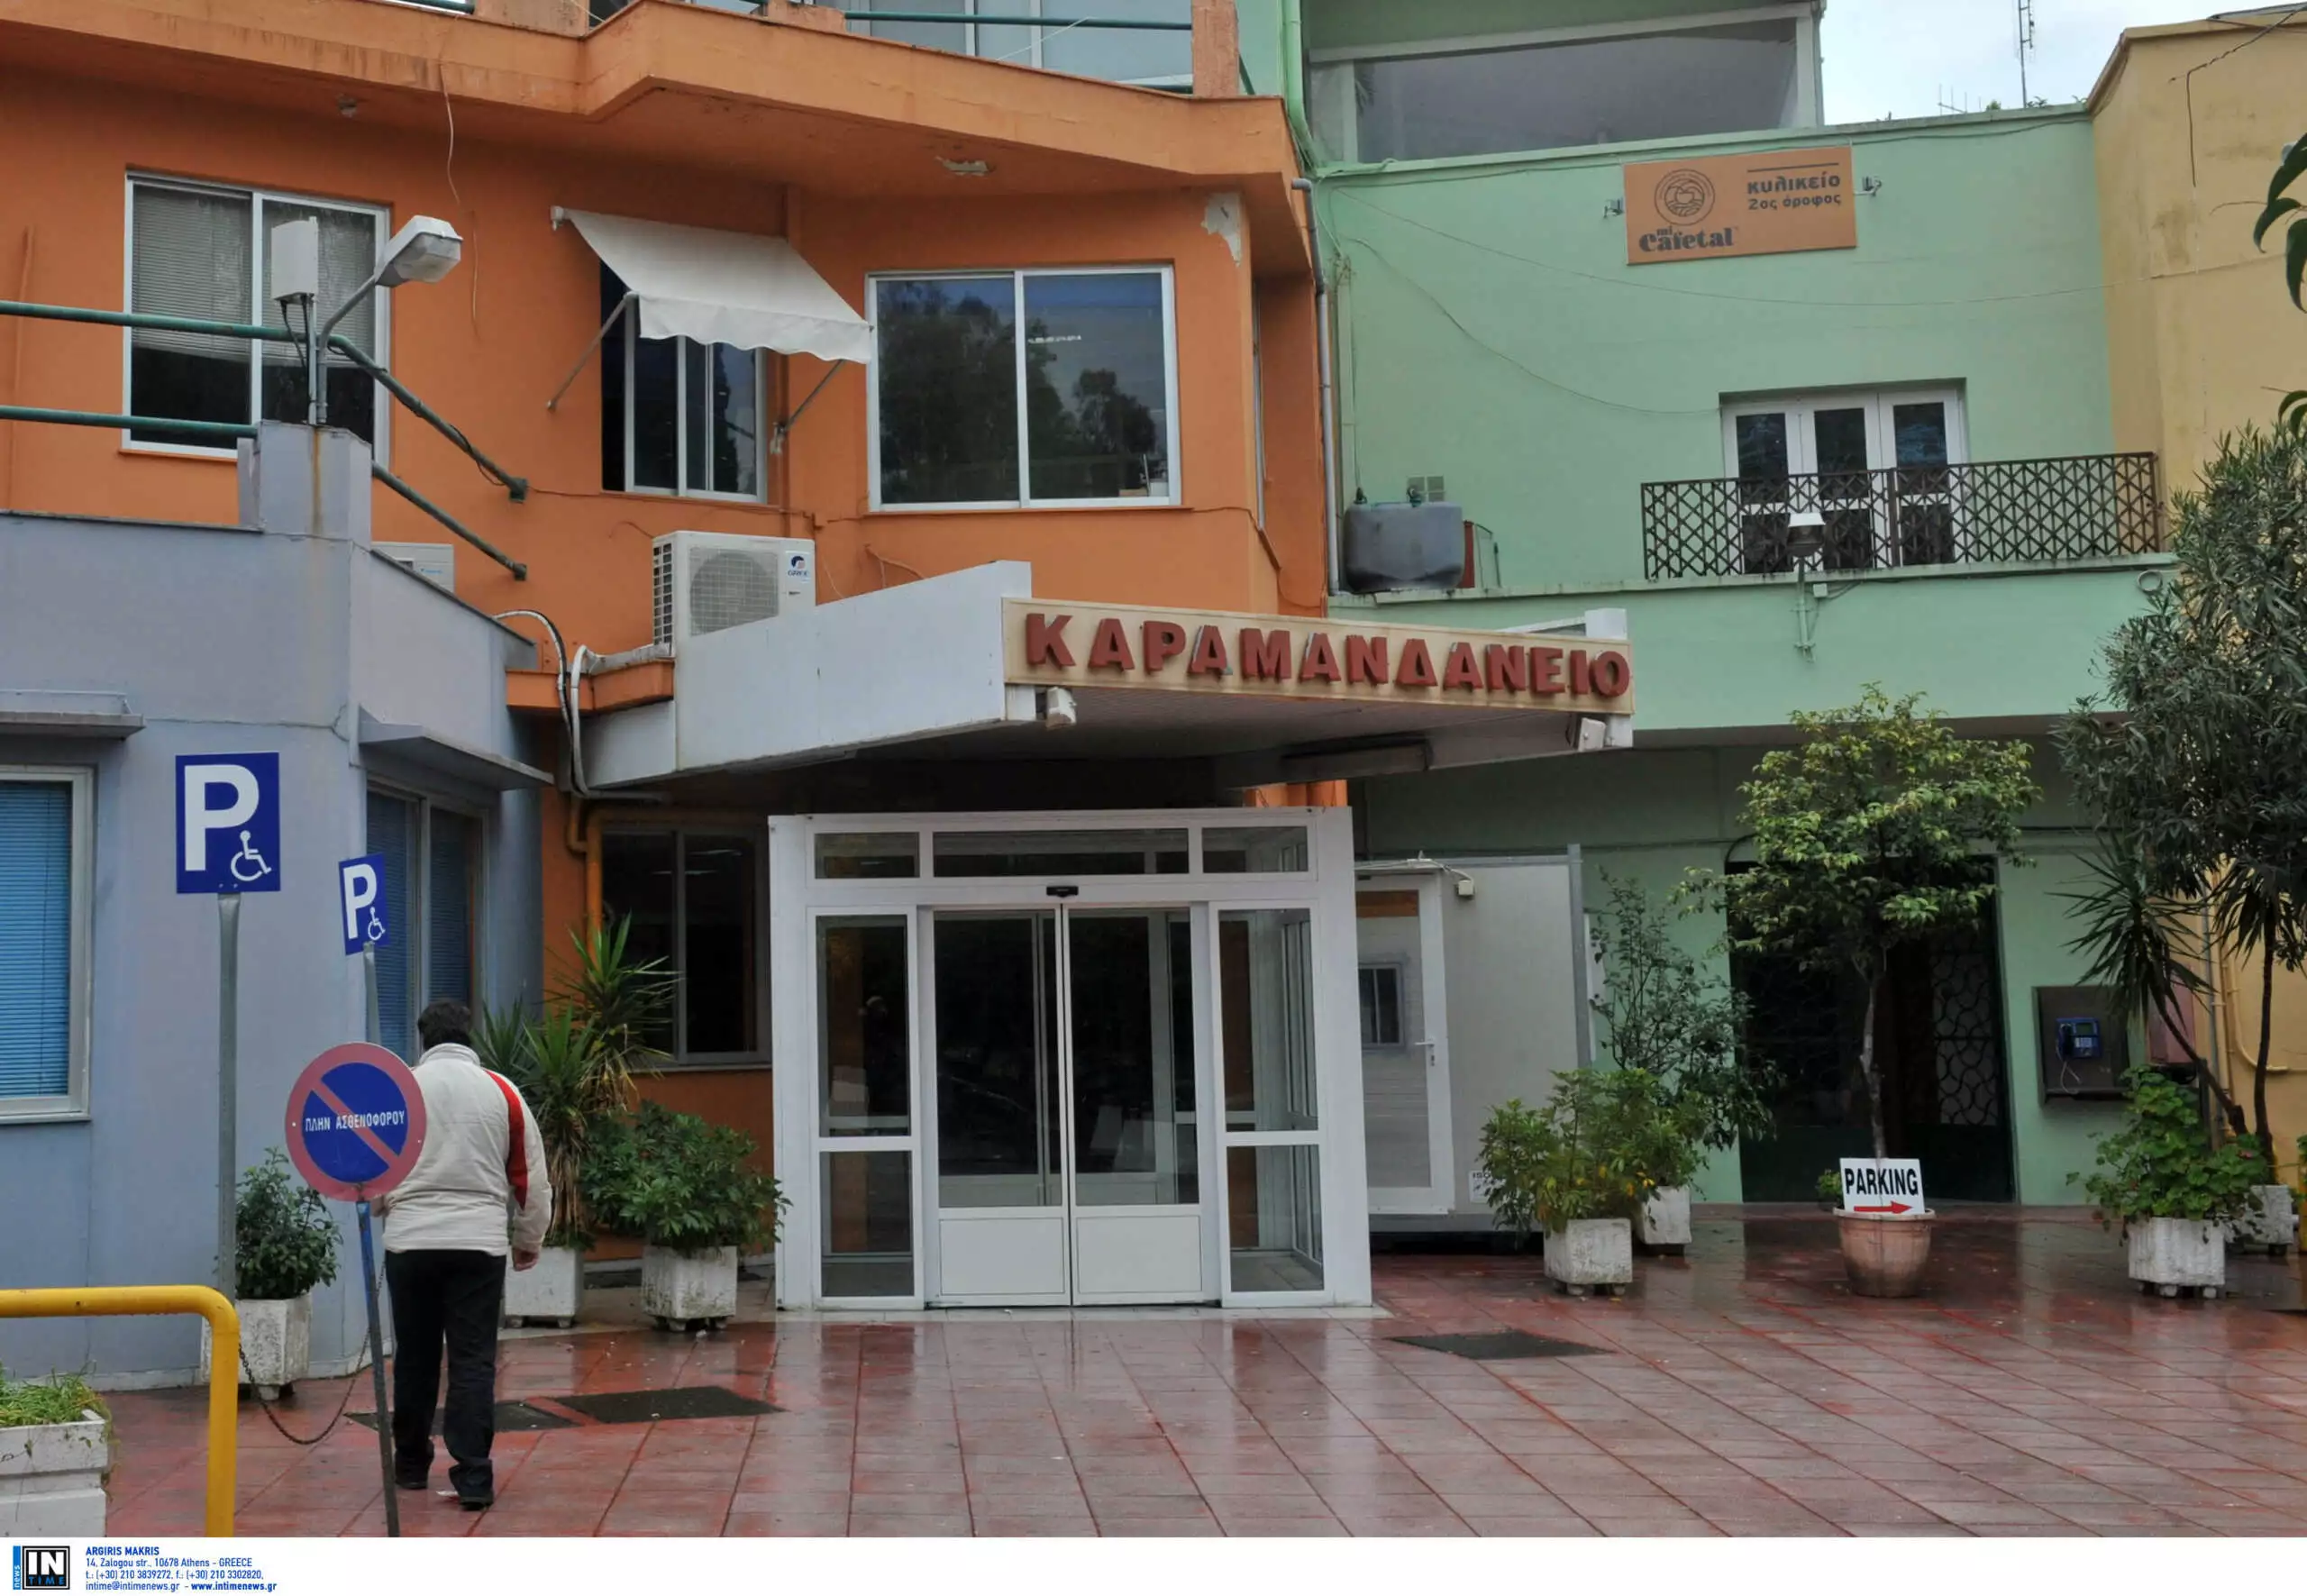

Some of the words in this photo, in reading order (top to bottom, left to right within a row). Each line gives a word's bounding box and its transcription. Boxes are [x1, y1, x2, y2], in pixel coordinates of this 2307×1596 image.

[1026, 612, 1631, 699] ΚΑΡΑΜΑΝΔΑΝΕΙΟ
[184, 763, 260, 871] P
[342, 862, 378, 940] P
[305, 1117, 331, 1132] ΠΛΗΝ
[335, 1110, 405, 1130] ΑΣΘΕΝΟΦΟΡΟΥ
[1844, 1168, 1919, 1196] PARKING
